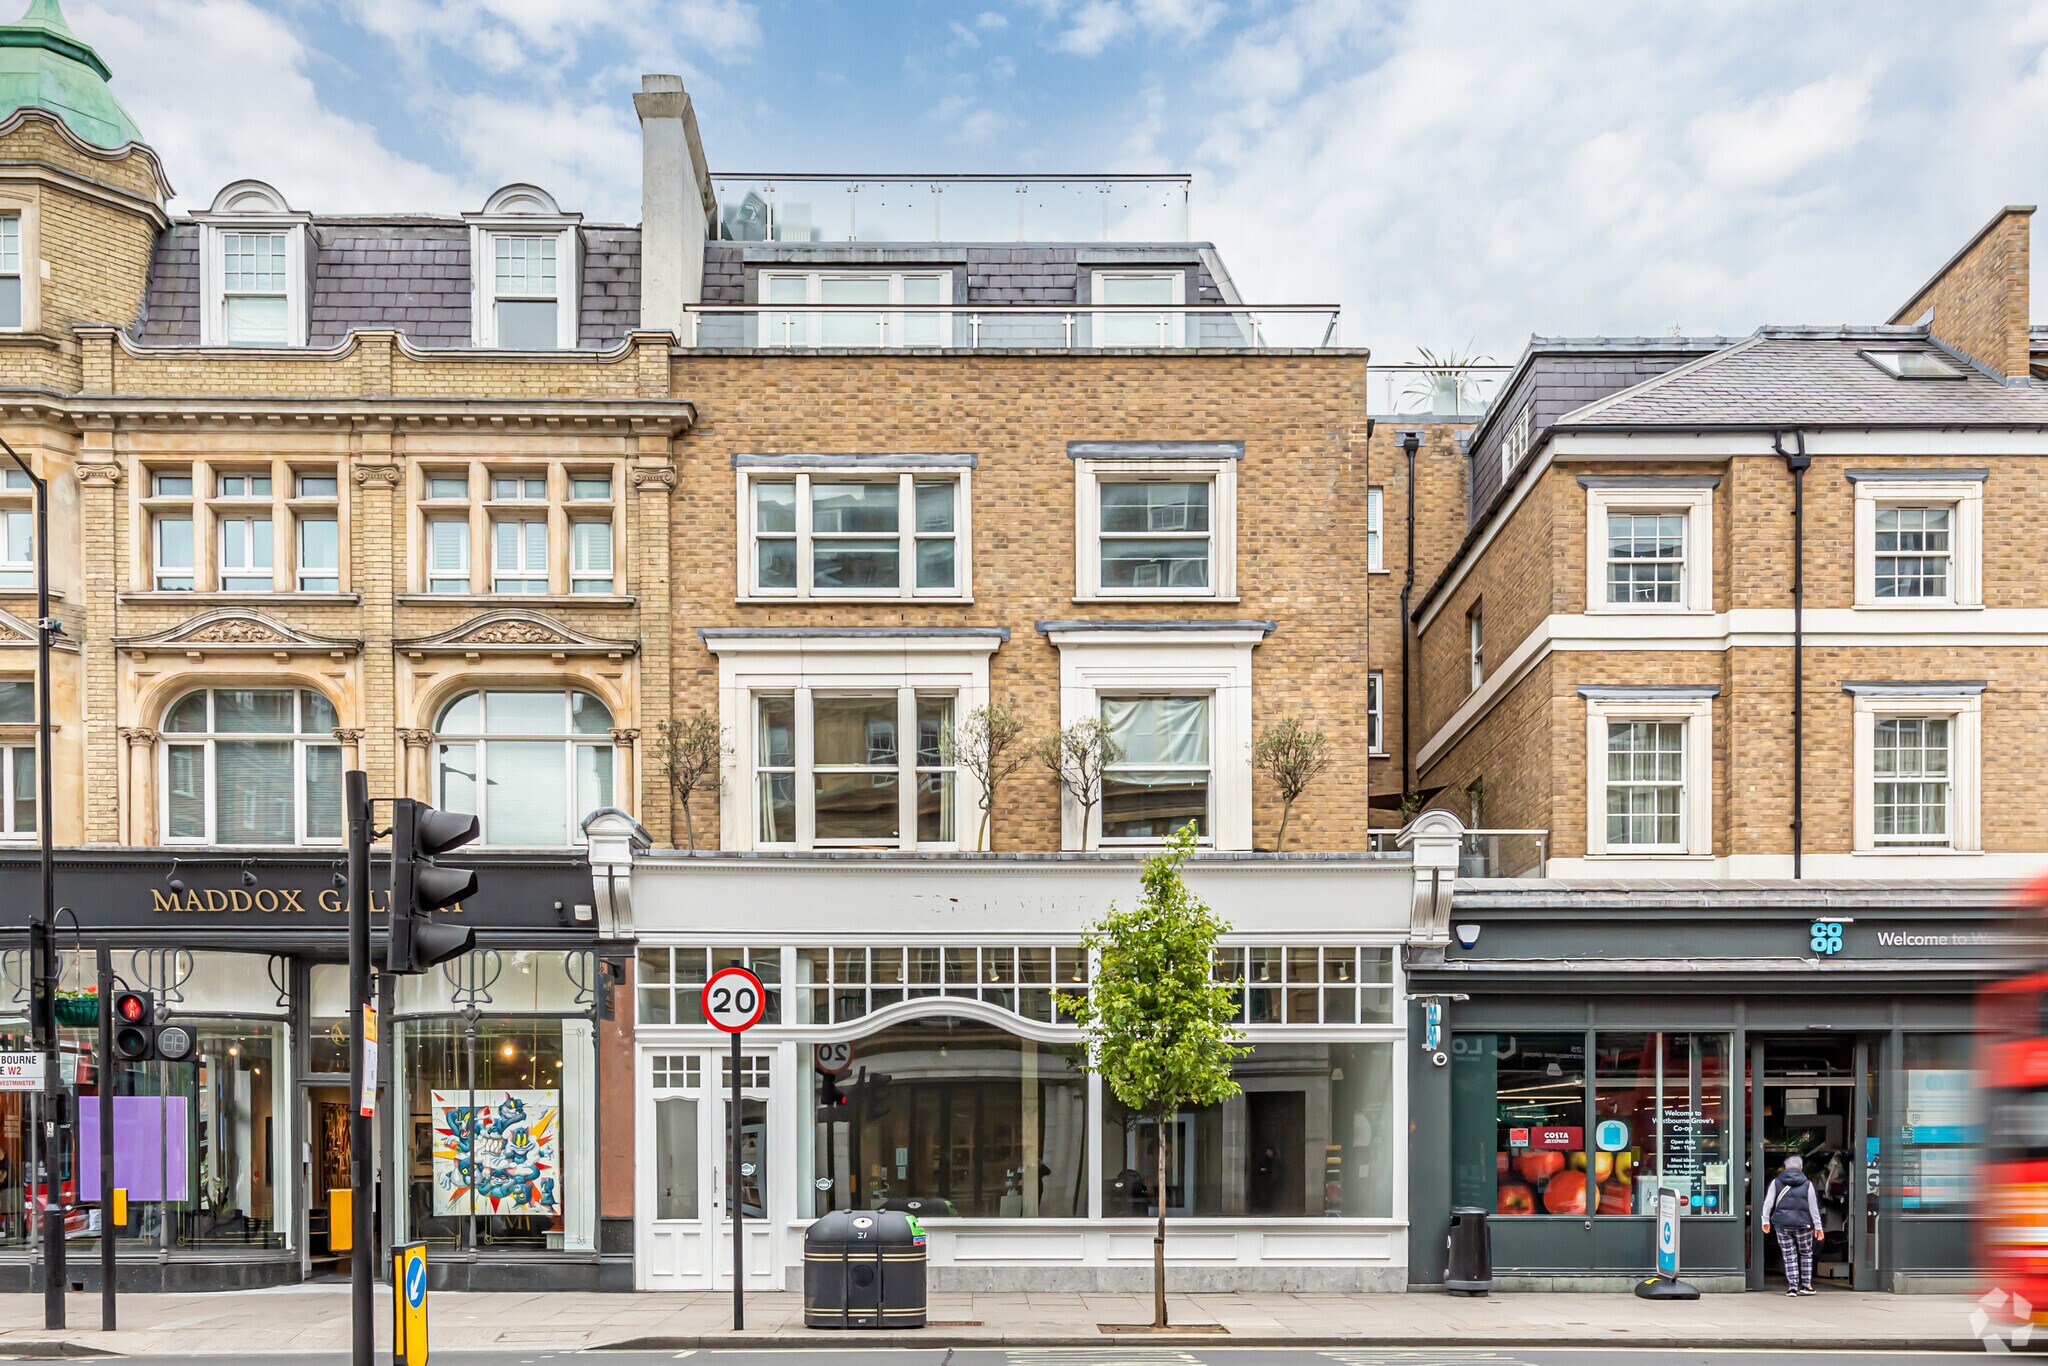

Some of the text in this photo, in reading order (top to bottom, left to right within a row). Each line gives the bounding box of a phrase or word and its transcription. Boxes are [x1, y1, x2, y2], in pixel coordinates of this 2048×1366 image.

[150, 889, 306, 913] MADDOX
[1877, 931, 1948, 946] Welcome
[1951, 932, 1968, 946] to
[712, 987, 756, 1014] 20
[8, 1066, 22, 1075] W2
[1544, 1132, 1569, 1140] COSTA
